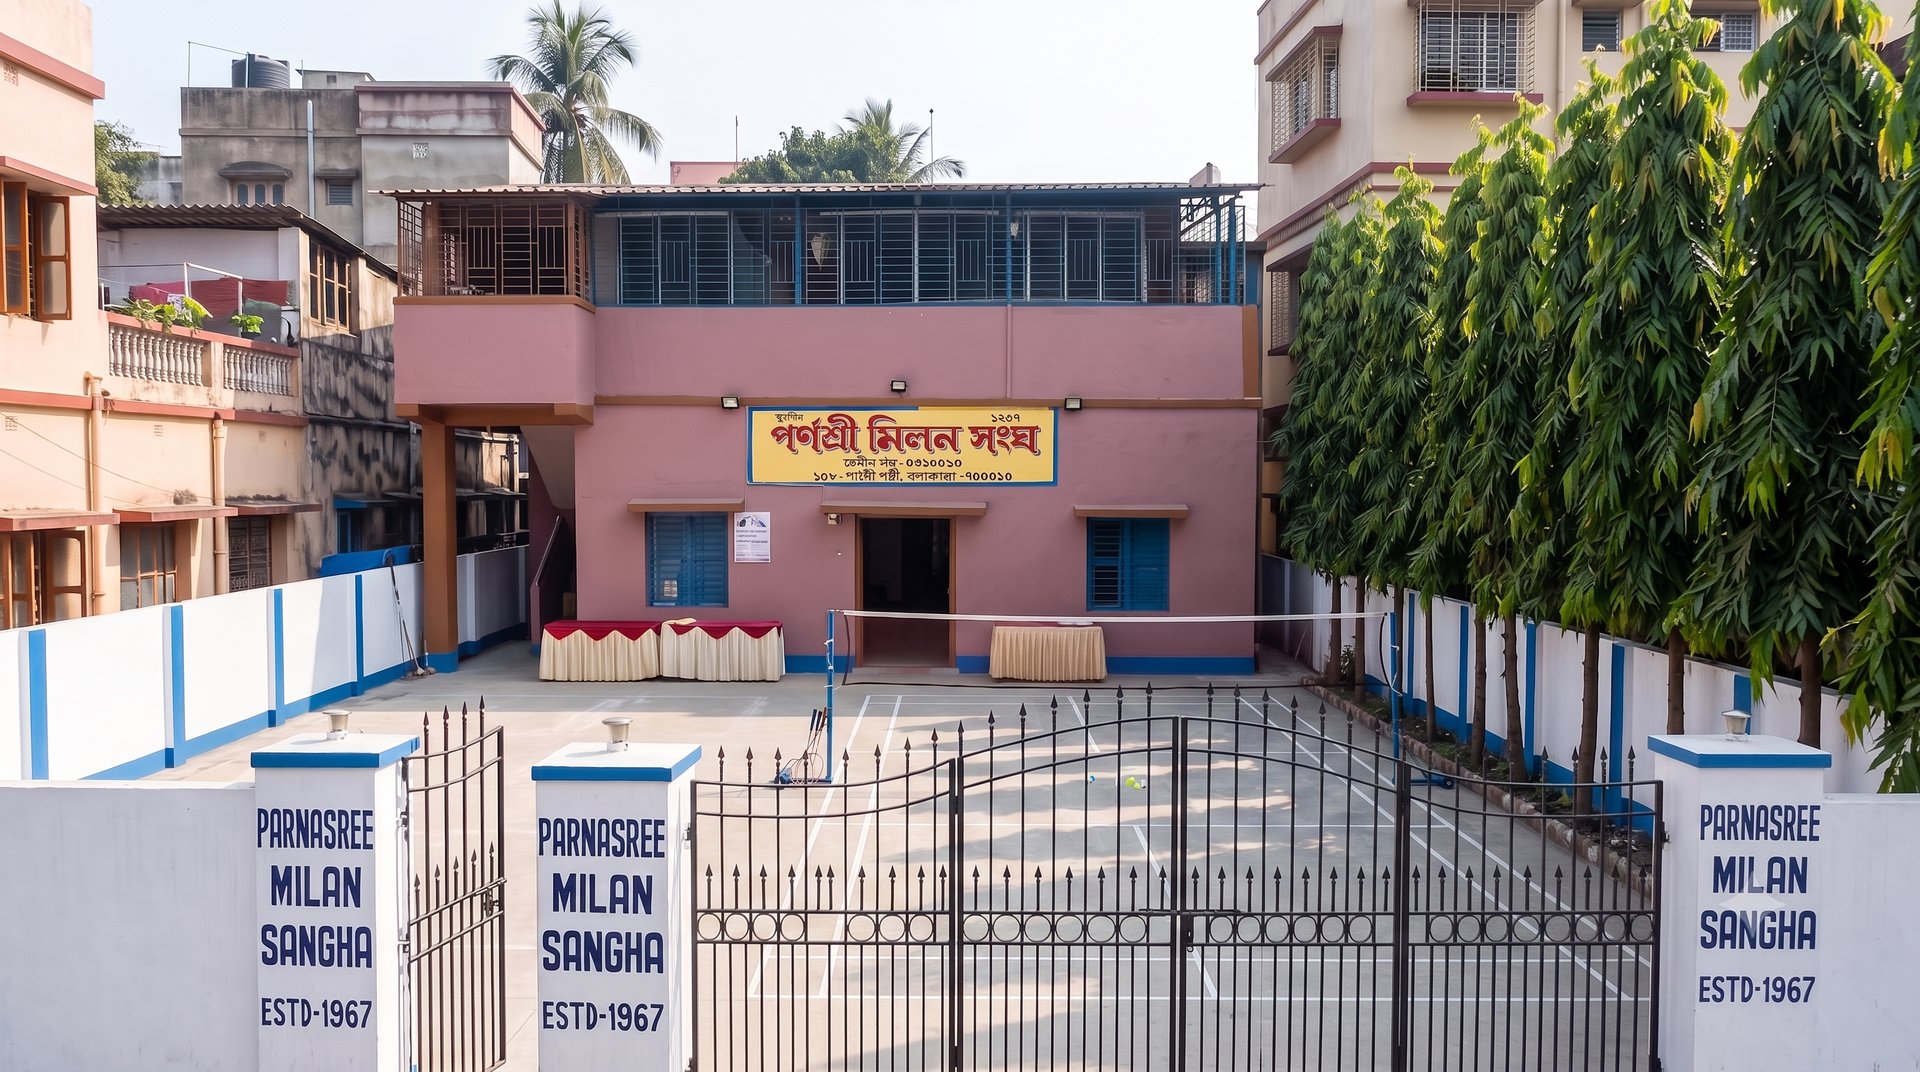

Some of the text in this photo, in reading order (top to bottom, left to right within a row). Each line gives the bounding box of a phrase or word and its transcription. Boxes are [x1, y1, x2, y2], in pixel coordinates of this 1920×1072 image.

[770, 413, 1041, 456] পর্ণশ্রী মিলন সংঘ
[991, 413, 1021, 423] ১২৩৭
[257, 807, 374, 849] PARNASREE
[538, 817, 666, 858] PARNASREE
[1700, 804, 1821, 842] PARNASREE
[271, 865, 362, 908] MILAN
[552, 872, 653, 915] MILAN
[1712, 856, 1808, 894] MILAN
[261, 924, 373, 968] SANGHA
[1700, 910, 1817, 950] SANGHA
[542, 930, 664, 974] SANGHA
[1699, 975, 1816, 1003] ESTD-1967
[261, 998, 373, 1028] ESTD-1967
[542, 1001, 664, 1032] ESTD-1967
